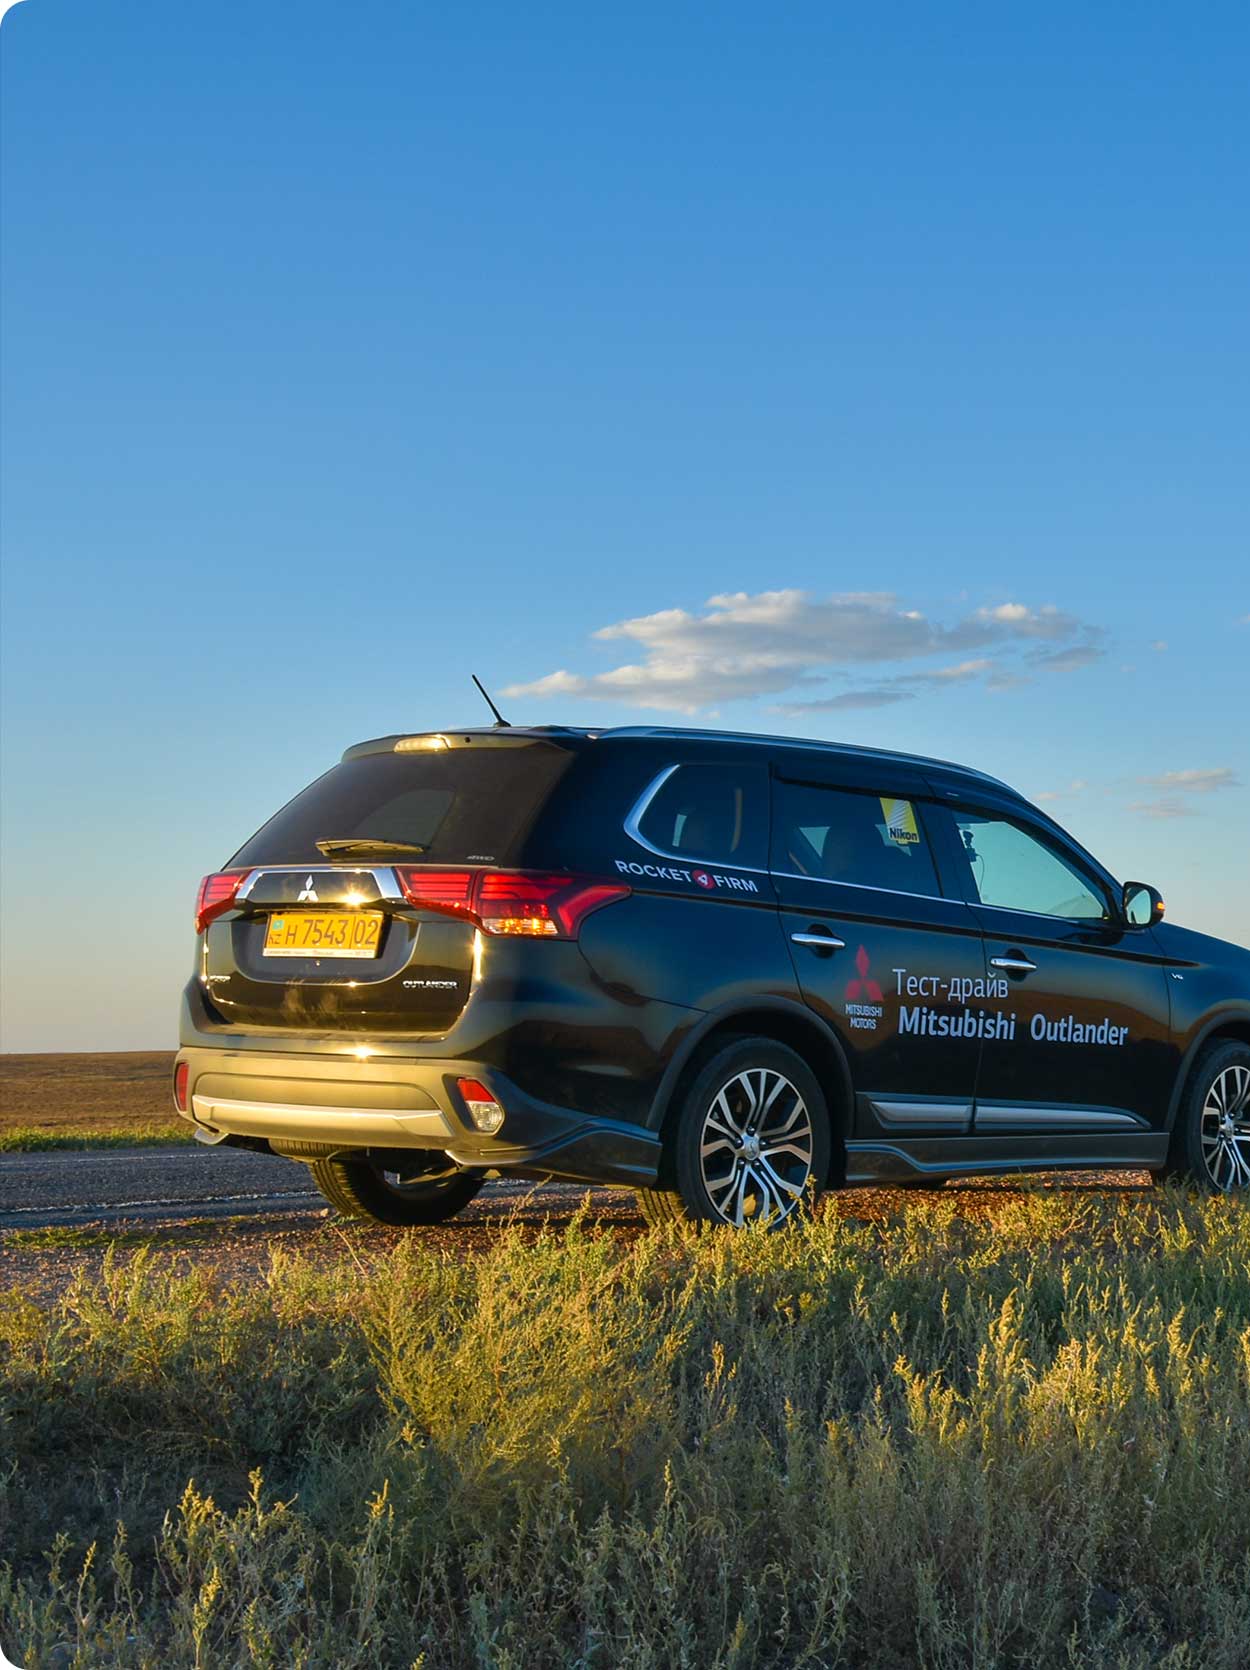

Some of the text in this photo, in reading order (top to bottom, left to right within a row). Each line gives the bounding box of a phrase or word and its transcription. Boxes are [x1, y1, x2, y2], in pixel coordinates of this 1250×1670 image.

[889, 827, 918, 841] Nikon
[614, 860, 759, 893] ROCKET FIRM
[302, 919, 349, 945] 7543
[354, 919, 379, 945] 02
[402, 980, 458, 989] OUTLANDER
[892, 968, 1009, 1004] Тест-драйв
[845, 1003, 883, 1017] MITSUBISHI
[850, 1017, 877, 1030] MOTORS
[898, 1005, 1129, 1046] Mitsubishi Outlander
